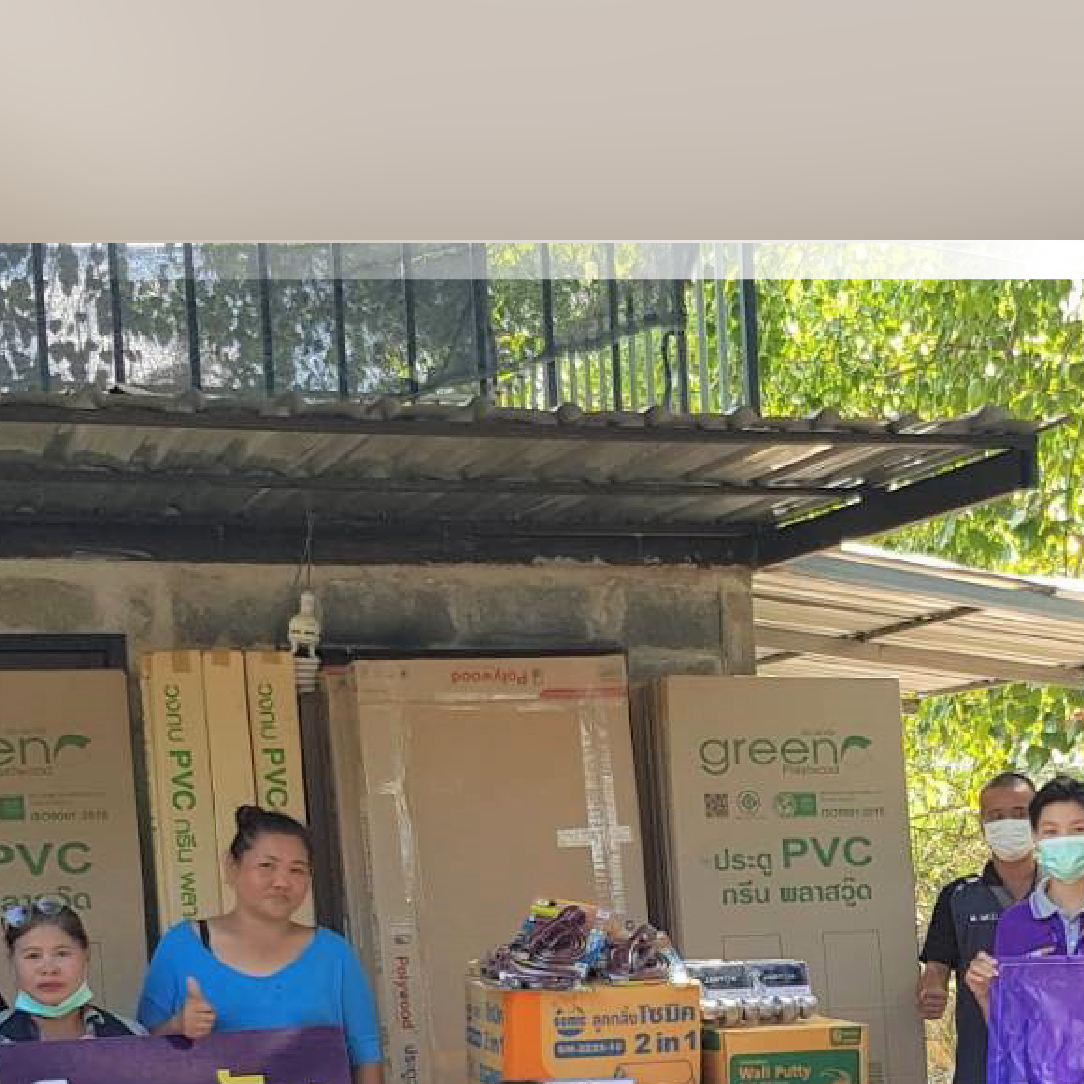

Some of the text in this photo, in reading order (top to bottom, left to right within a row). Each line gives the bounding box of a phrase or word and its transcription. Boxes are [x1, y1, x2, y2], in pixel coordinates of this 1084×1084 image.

[699, 738, 838, 776] green
[169, 750, 197, 811] PVC
[262, 749, 288, 807] PVC
[714, 837, 872, 877] ประตู PVC
[634, 1033, 652, 1054] 2
[656, 1032, 679, 1052] in
[683, 1029, 697, 1050] 1
